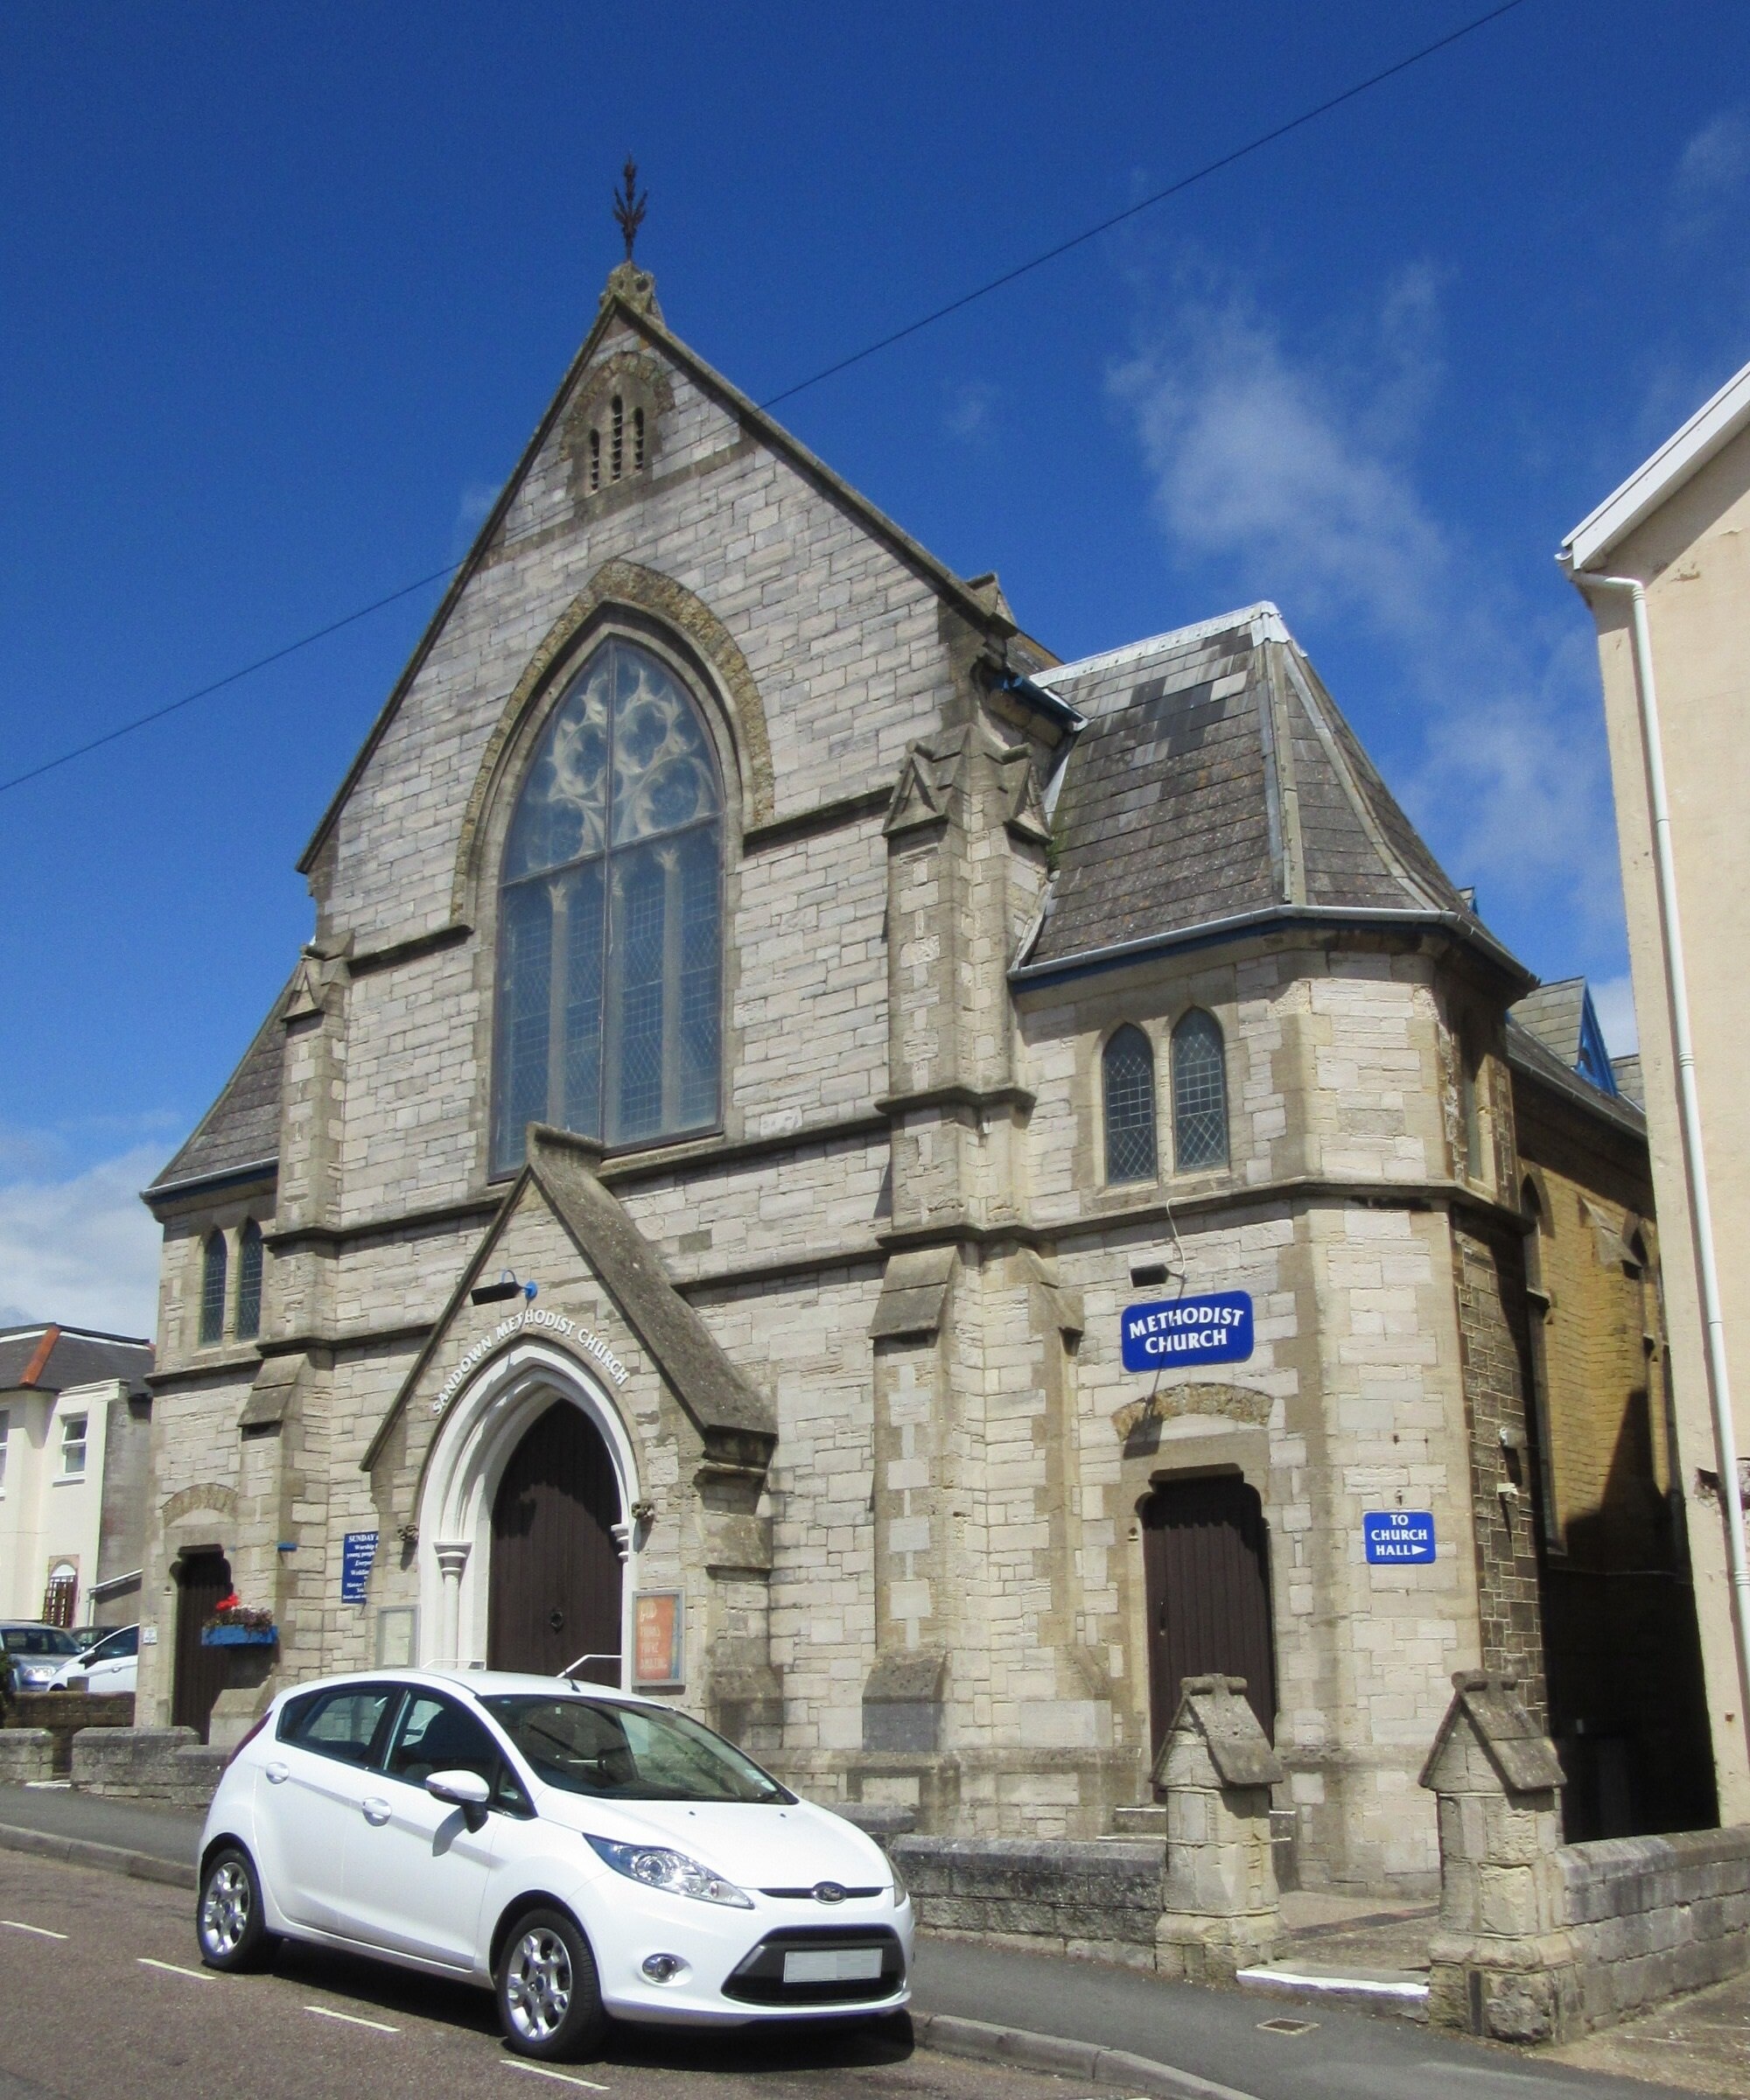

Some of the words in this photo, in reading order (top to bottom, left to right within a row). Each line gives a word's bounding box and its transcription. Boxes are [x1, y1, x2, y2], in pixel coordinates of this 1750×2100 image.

[1129, 1306, 1244, 1340] METHODIST
[1144, 1328, 1228, 1354] CHURCH
[431, 1335, 493, 1416] SANDOWN
[495, 1309, 577, 1341] METHODIST
[578, 1328, 630, 1387] CHURCH
[1390, 1515, 1409, 1526] TO
[348, 1534, 374, 1543] SUNDAY
[1370, 1529, 1428, 1541] CHURCH
[1376, 1544, 1410, 1556] HALL
